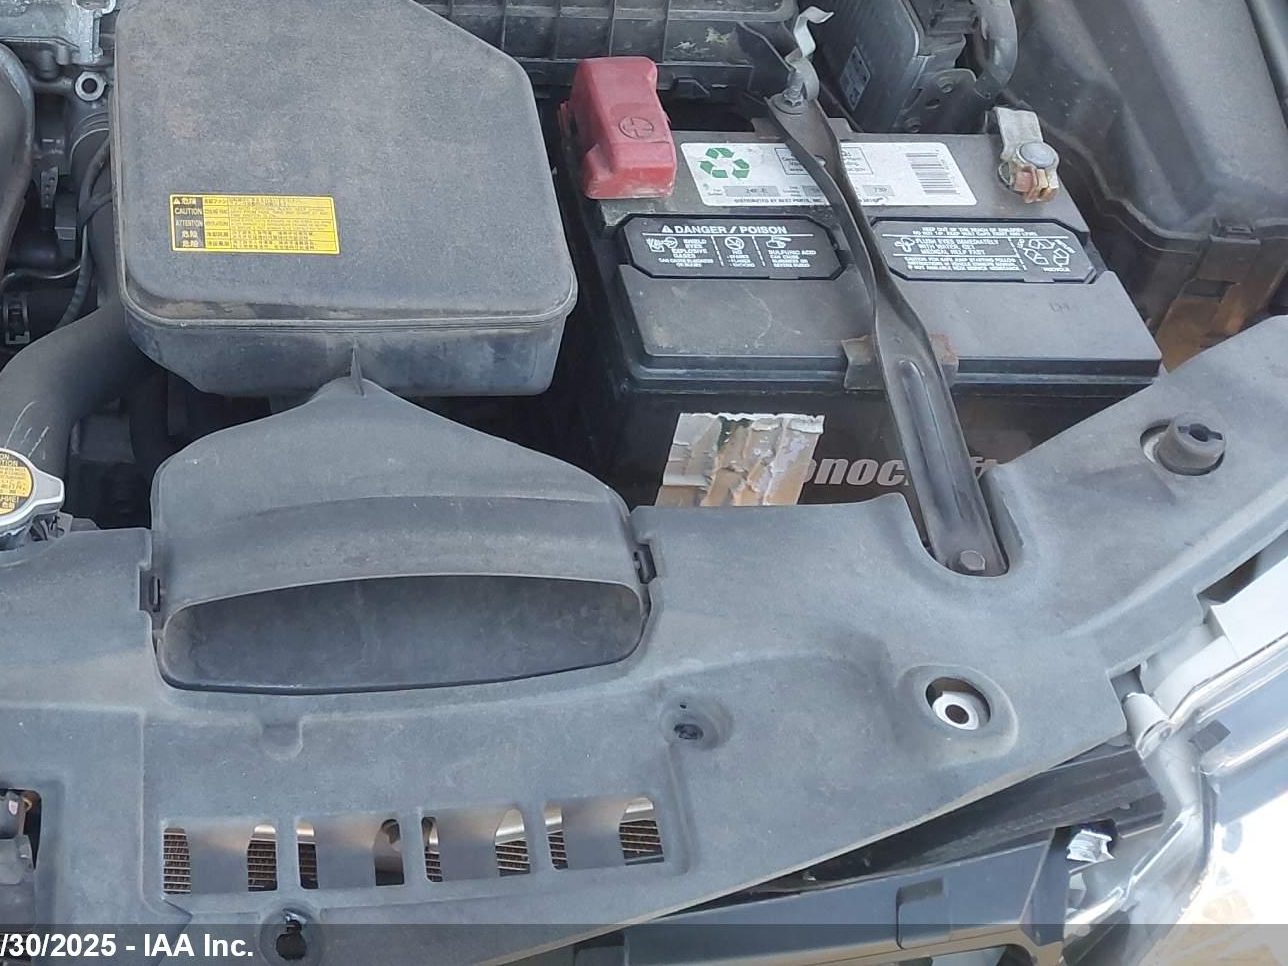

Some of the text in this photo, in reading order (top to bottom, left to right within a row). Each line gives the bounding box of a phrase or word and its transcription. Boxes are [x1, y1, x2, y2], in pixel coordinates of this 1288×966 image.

[175, 207, 203, 215] CAUTION
[673, 225, 726, 234] DANGER
[739, 226, 788, 234] POISON
